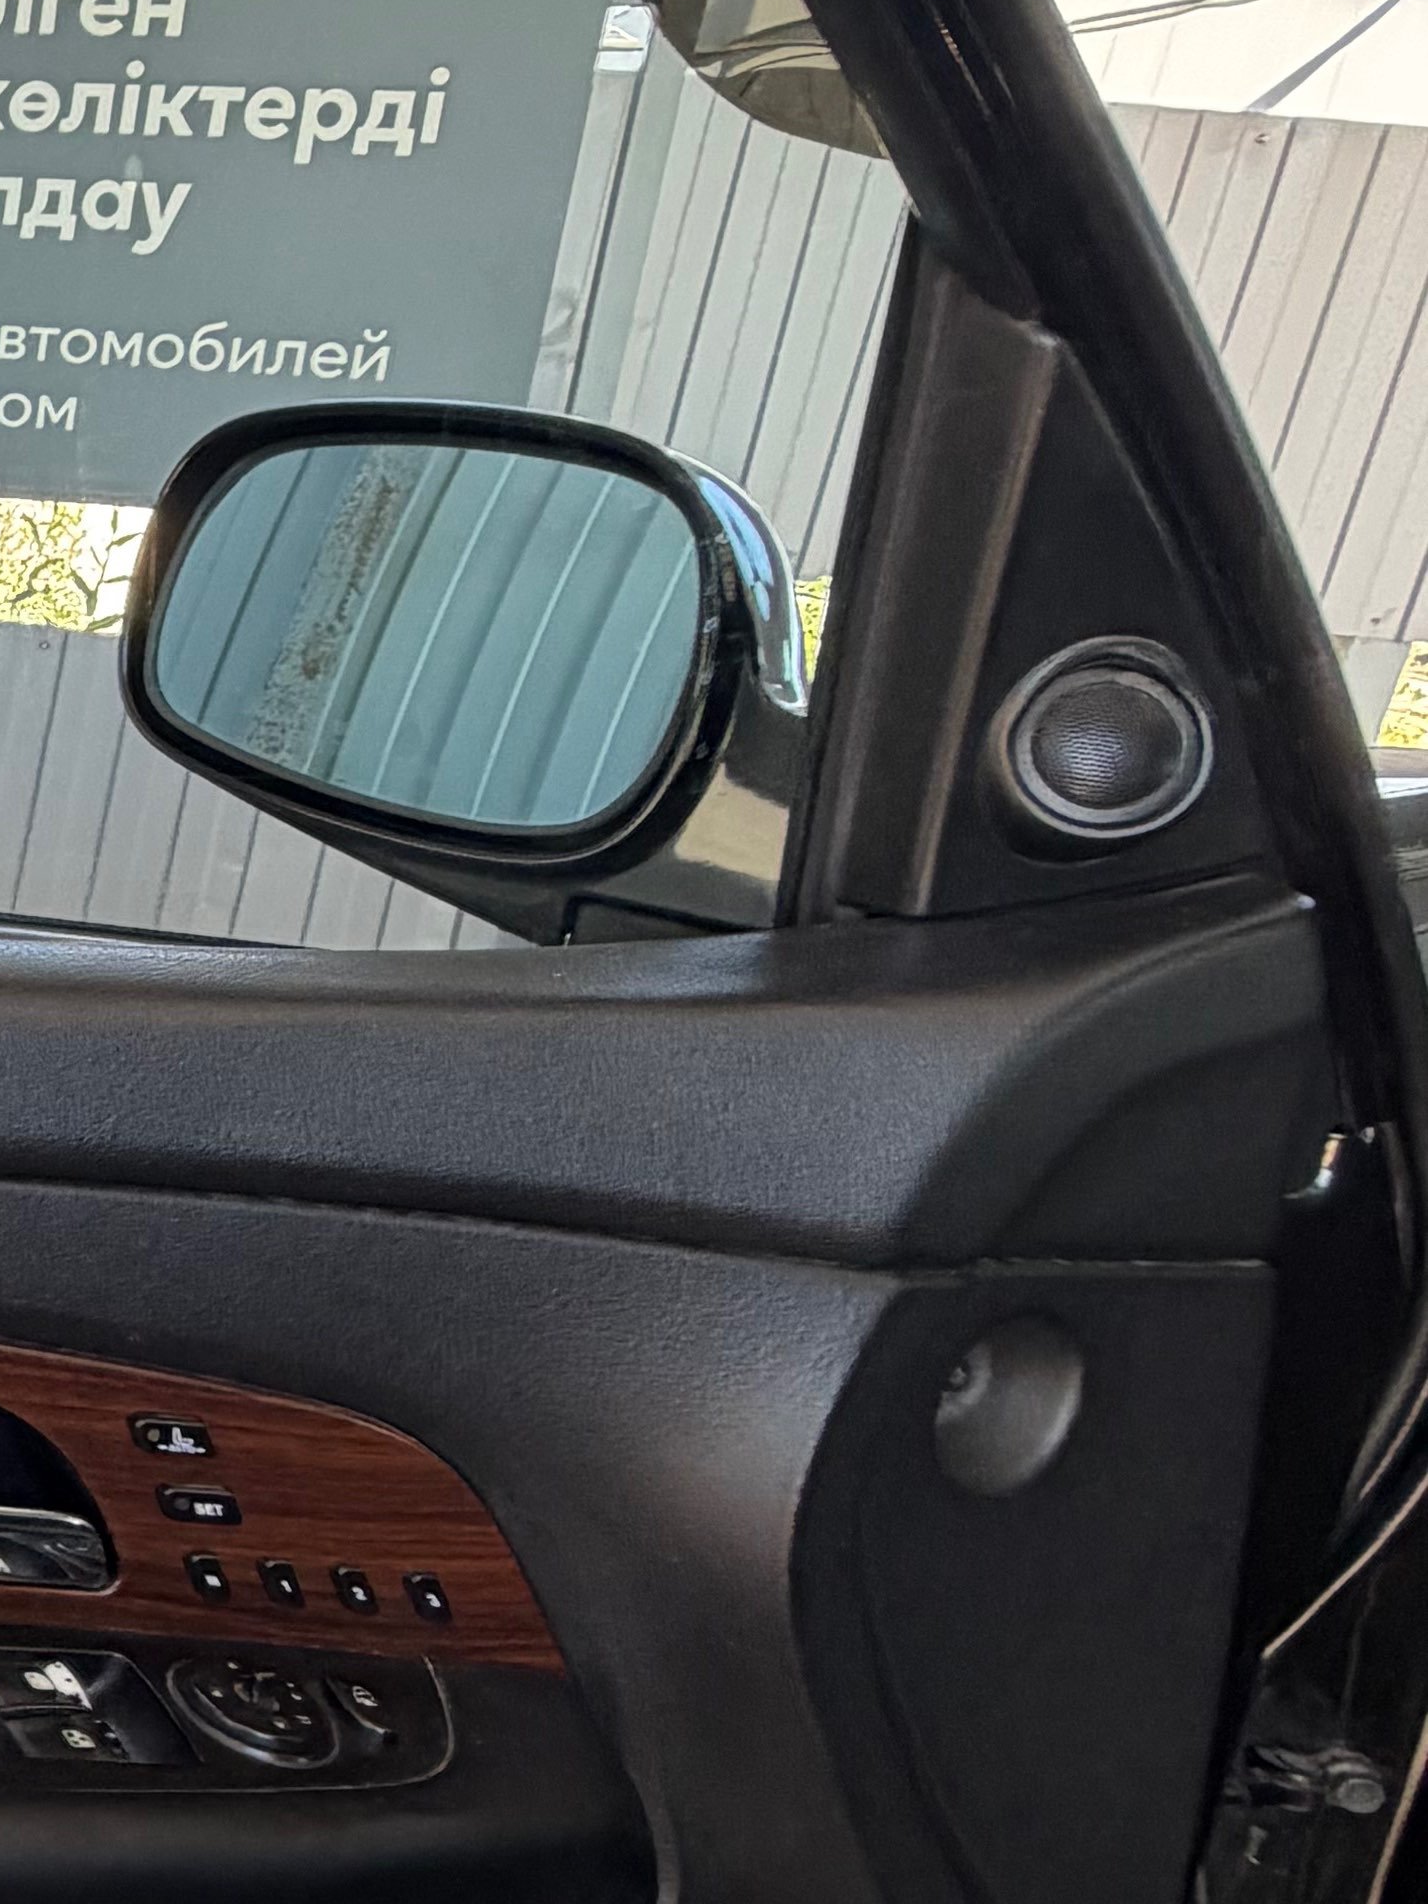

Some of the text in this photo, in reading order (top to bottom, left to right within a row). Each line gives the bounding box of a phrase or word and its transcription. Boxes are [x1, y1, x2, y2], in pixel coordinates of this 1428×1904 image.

[193, 1502, 224, 1517] SET
[280, 1580, 442, 1608] 1 2 3
